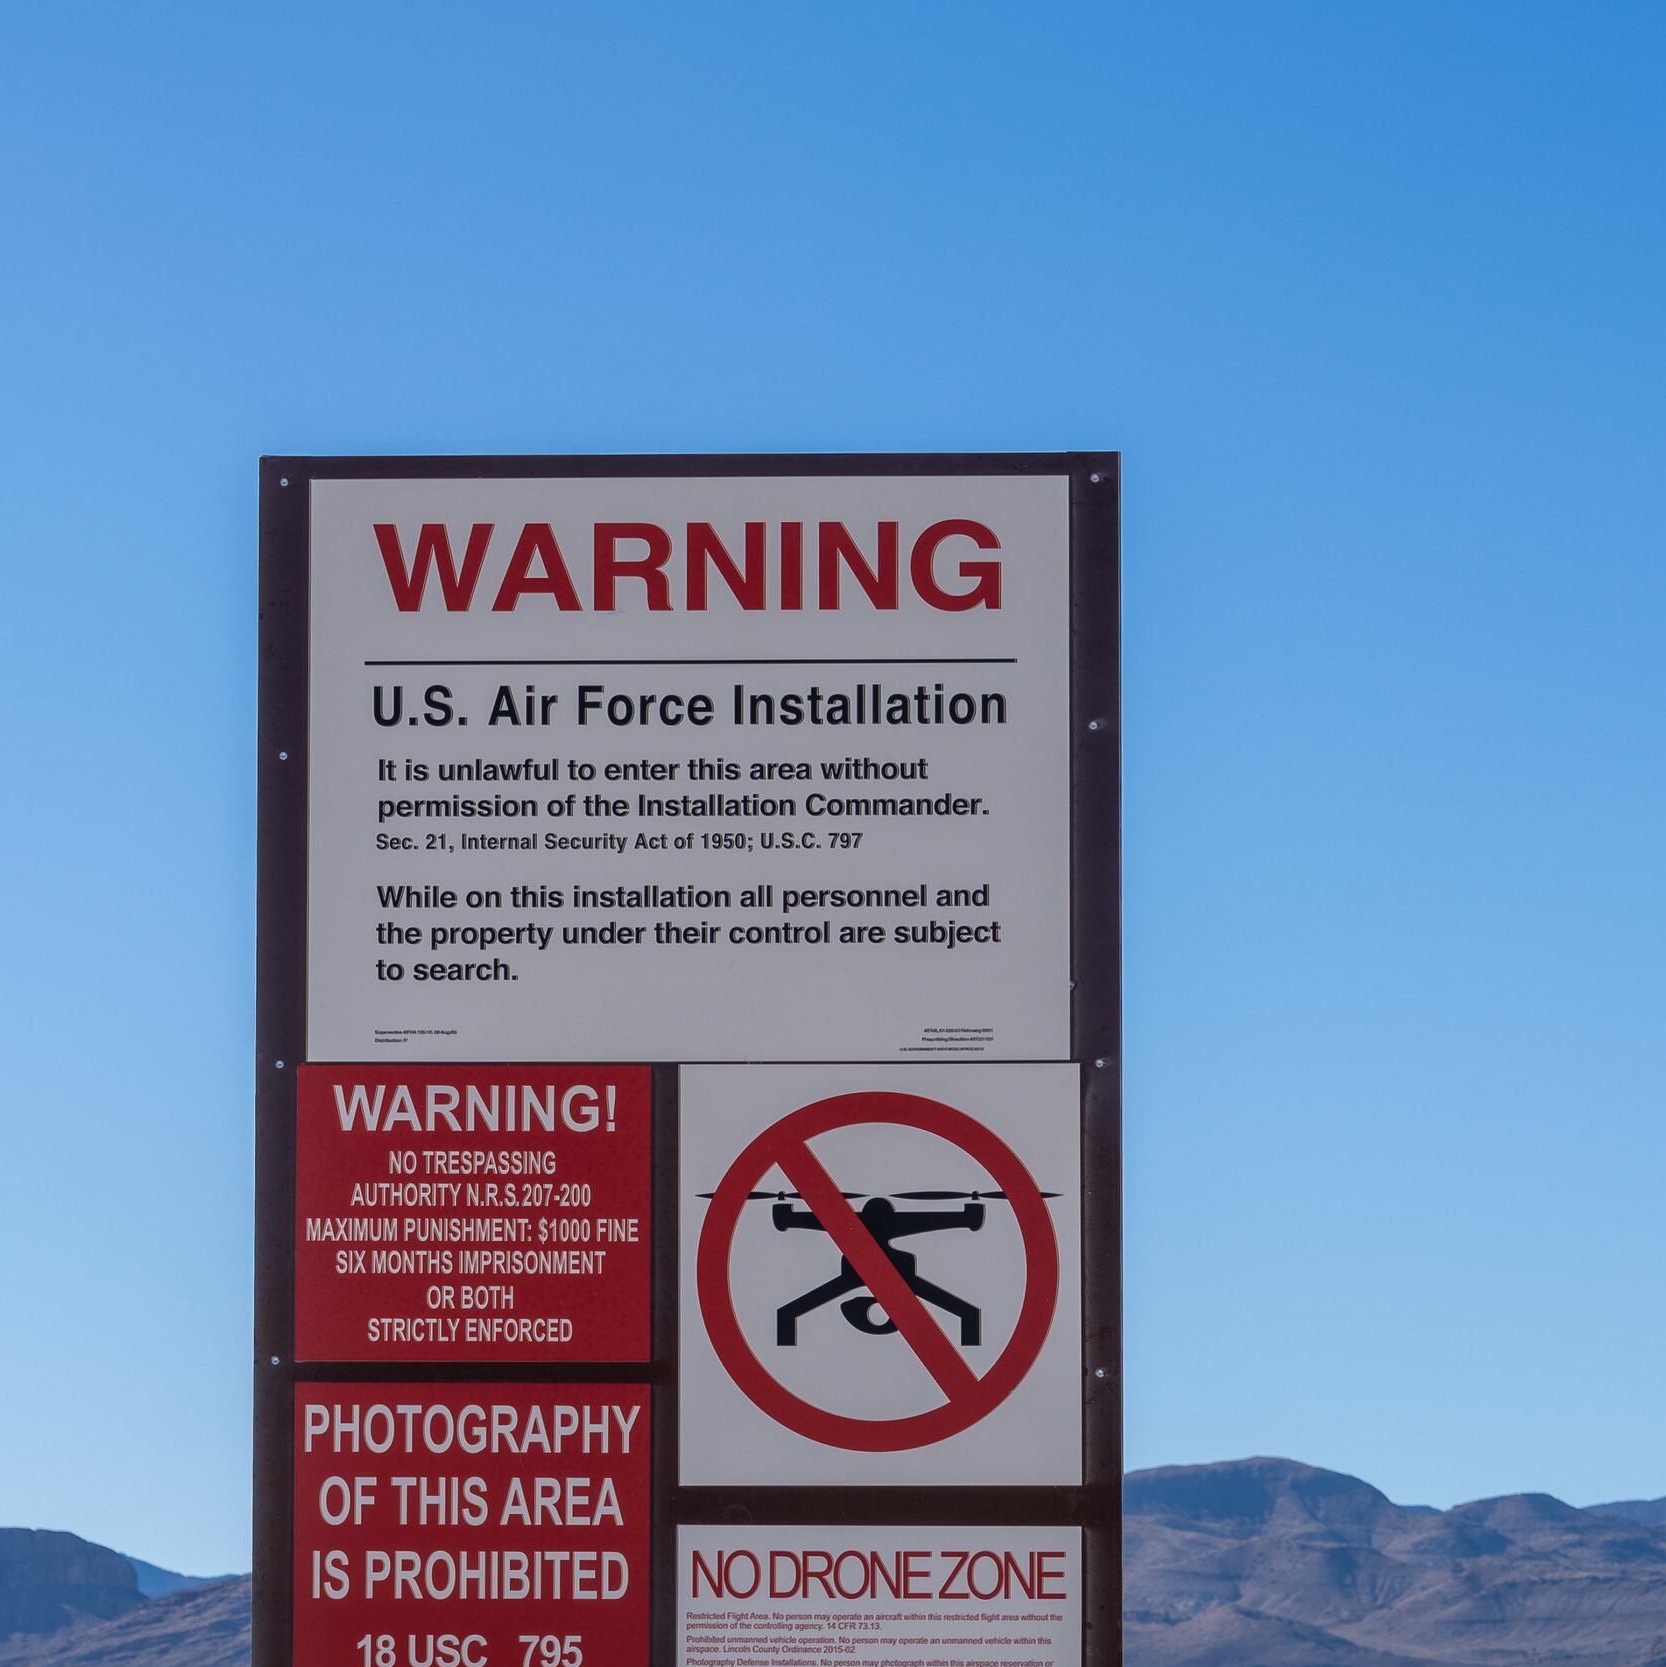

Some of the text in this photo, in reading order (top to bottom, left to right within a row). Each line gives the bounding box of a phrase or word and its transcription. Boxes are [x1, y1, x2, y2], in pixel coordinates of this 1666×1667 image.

[373, 519, 1001, 612] WARNING
[374, 684, 1006, 726] U.S. Air Force Installation
[379, 758, 928, 781] It is unlawful to enter this area without
[379, 793, 989, 823] permission of the Installation Commander.
[377, 832, 863, 853] Sec. 21, Internal Security Act of 1950; U.S.C. 797
[377, 884, 989, 913] While on this installation all personnel and
[376, 920, 1001, 950] the property under their control are subject
[376, 958, 518, 980] to search.
[333, 1085, 615, 1132] WARNING!
[390, 1151, 555, 1174] NO TRESPASSING
[351, 1183, 461, 1206] AUTHORITY
[307, 1217, 638, 1244] MAXIMUM PUNISHMENT: $1000 FINE
[336, 1250, 605, 1274] SIX MONTHS IMPRISONMENT
[427, 1286, 513, 1309] OR BOTH
[368, 1318, 572, 1342] STRICTLY ENFORCED
[305, 1404, 641, 1453] PHOTOGRAPHY
[319, 1476, 623, 1526] OF THIS AREA
[313, 1550, 628, 1600] IS PROHIBITED
[693, 1550, 1067, 1600] NO DRONE ZONE
[685, 1622, 728, 1631] permission
[752, 1623, 793, 1631] controlling
[686, 1612, 725, 1620] Restricted
[726, 1613, 749, 1622] Flight
[784, 1614, 812, 1622] person
[813, 1614, 831, 1622] may
[831, 1613, 862, 1622] operate
[874, 1613, 902, 1621] aircraft
[902, 1613, 926, 1621] within
[927, 1613, 942, 1621] this
[942, 1613, 979, 1621] restricted
[980, 1613, 1000, 1623] flight
[686, 1635, 725, 1643] Prohibited
[768, 1636, 797, 1644] vehicle
[838, 1636, 850, 1644] No
[879, 1638, 897, 1646] may
[898, 1636, 928, 1646] operate
[941, 1636, 983, 1644] unmanned
[1036, 1637, 1051, 1645] this
[751, 1646, 780, 1655] County
[686, 1659, 735, 1667] Photography
[880, 1659, 925, 1667] photograph
[925, 1659, 949, 1667] within
[949, 1659, 964, 1667] this
